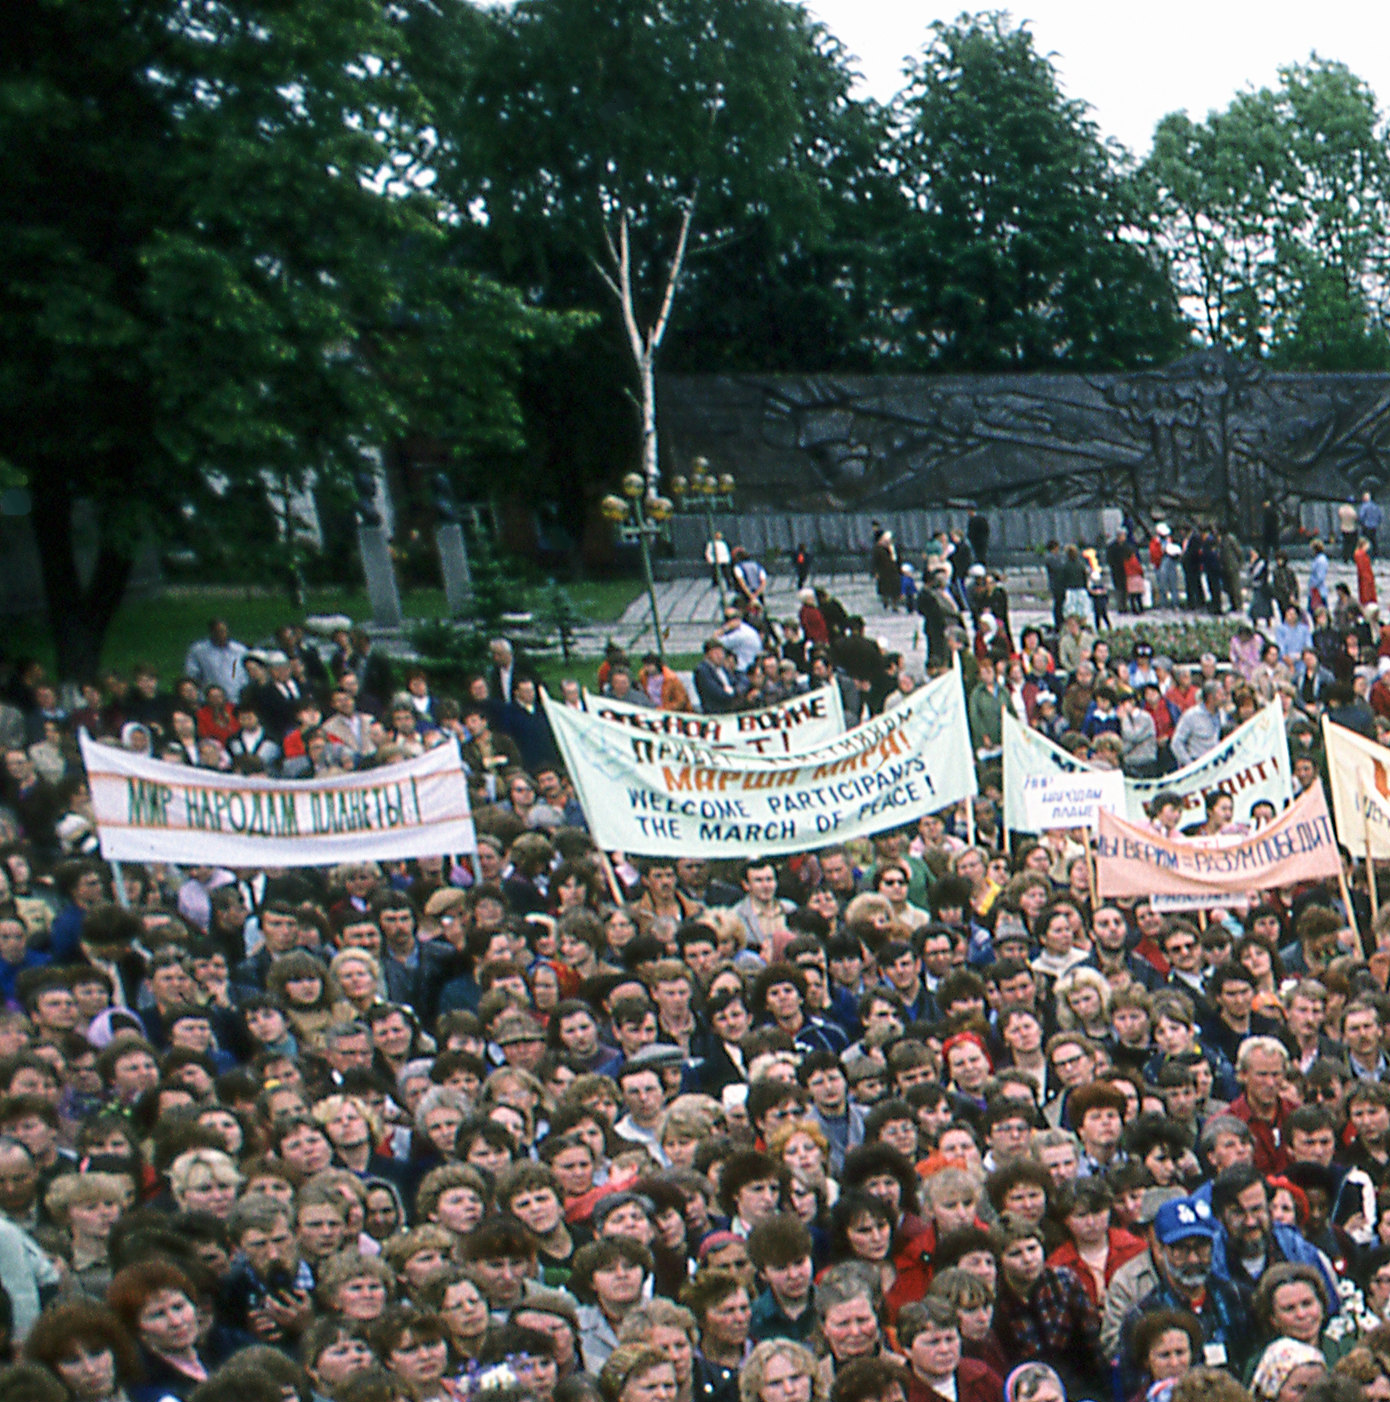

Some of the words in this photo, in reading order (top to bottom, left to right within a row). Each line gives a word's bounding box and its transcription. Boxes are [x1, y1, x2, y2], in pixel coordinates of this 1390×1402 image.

[626, 786, 751, 821] WELCOME
[766, 751, 927, 816] PARTICIPANTS
[660, 765, 801, 794] МАРША
[126, 776, 173, 828] МИР
[184, 784, 300, 838] НАРОДАМ
[635, 815, 682, 841] THE
[698, 819, 797, 843] MARCH
[814, 811, 844, 835] OF
